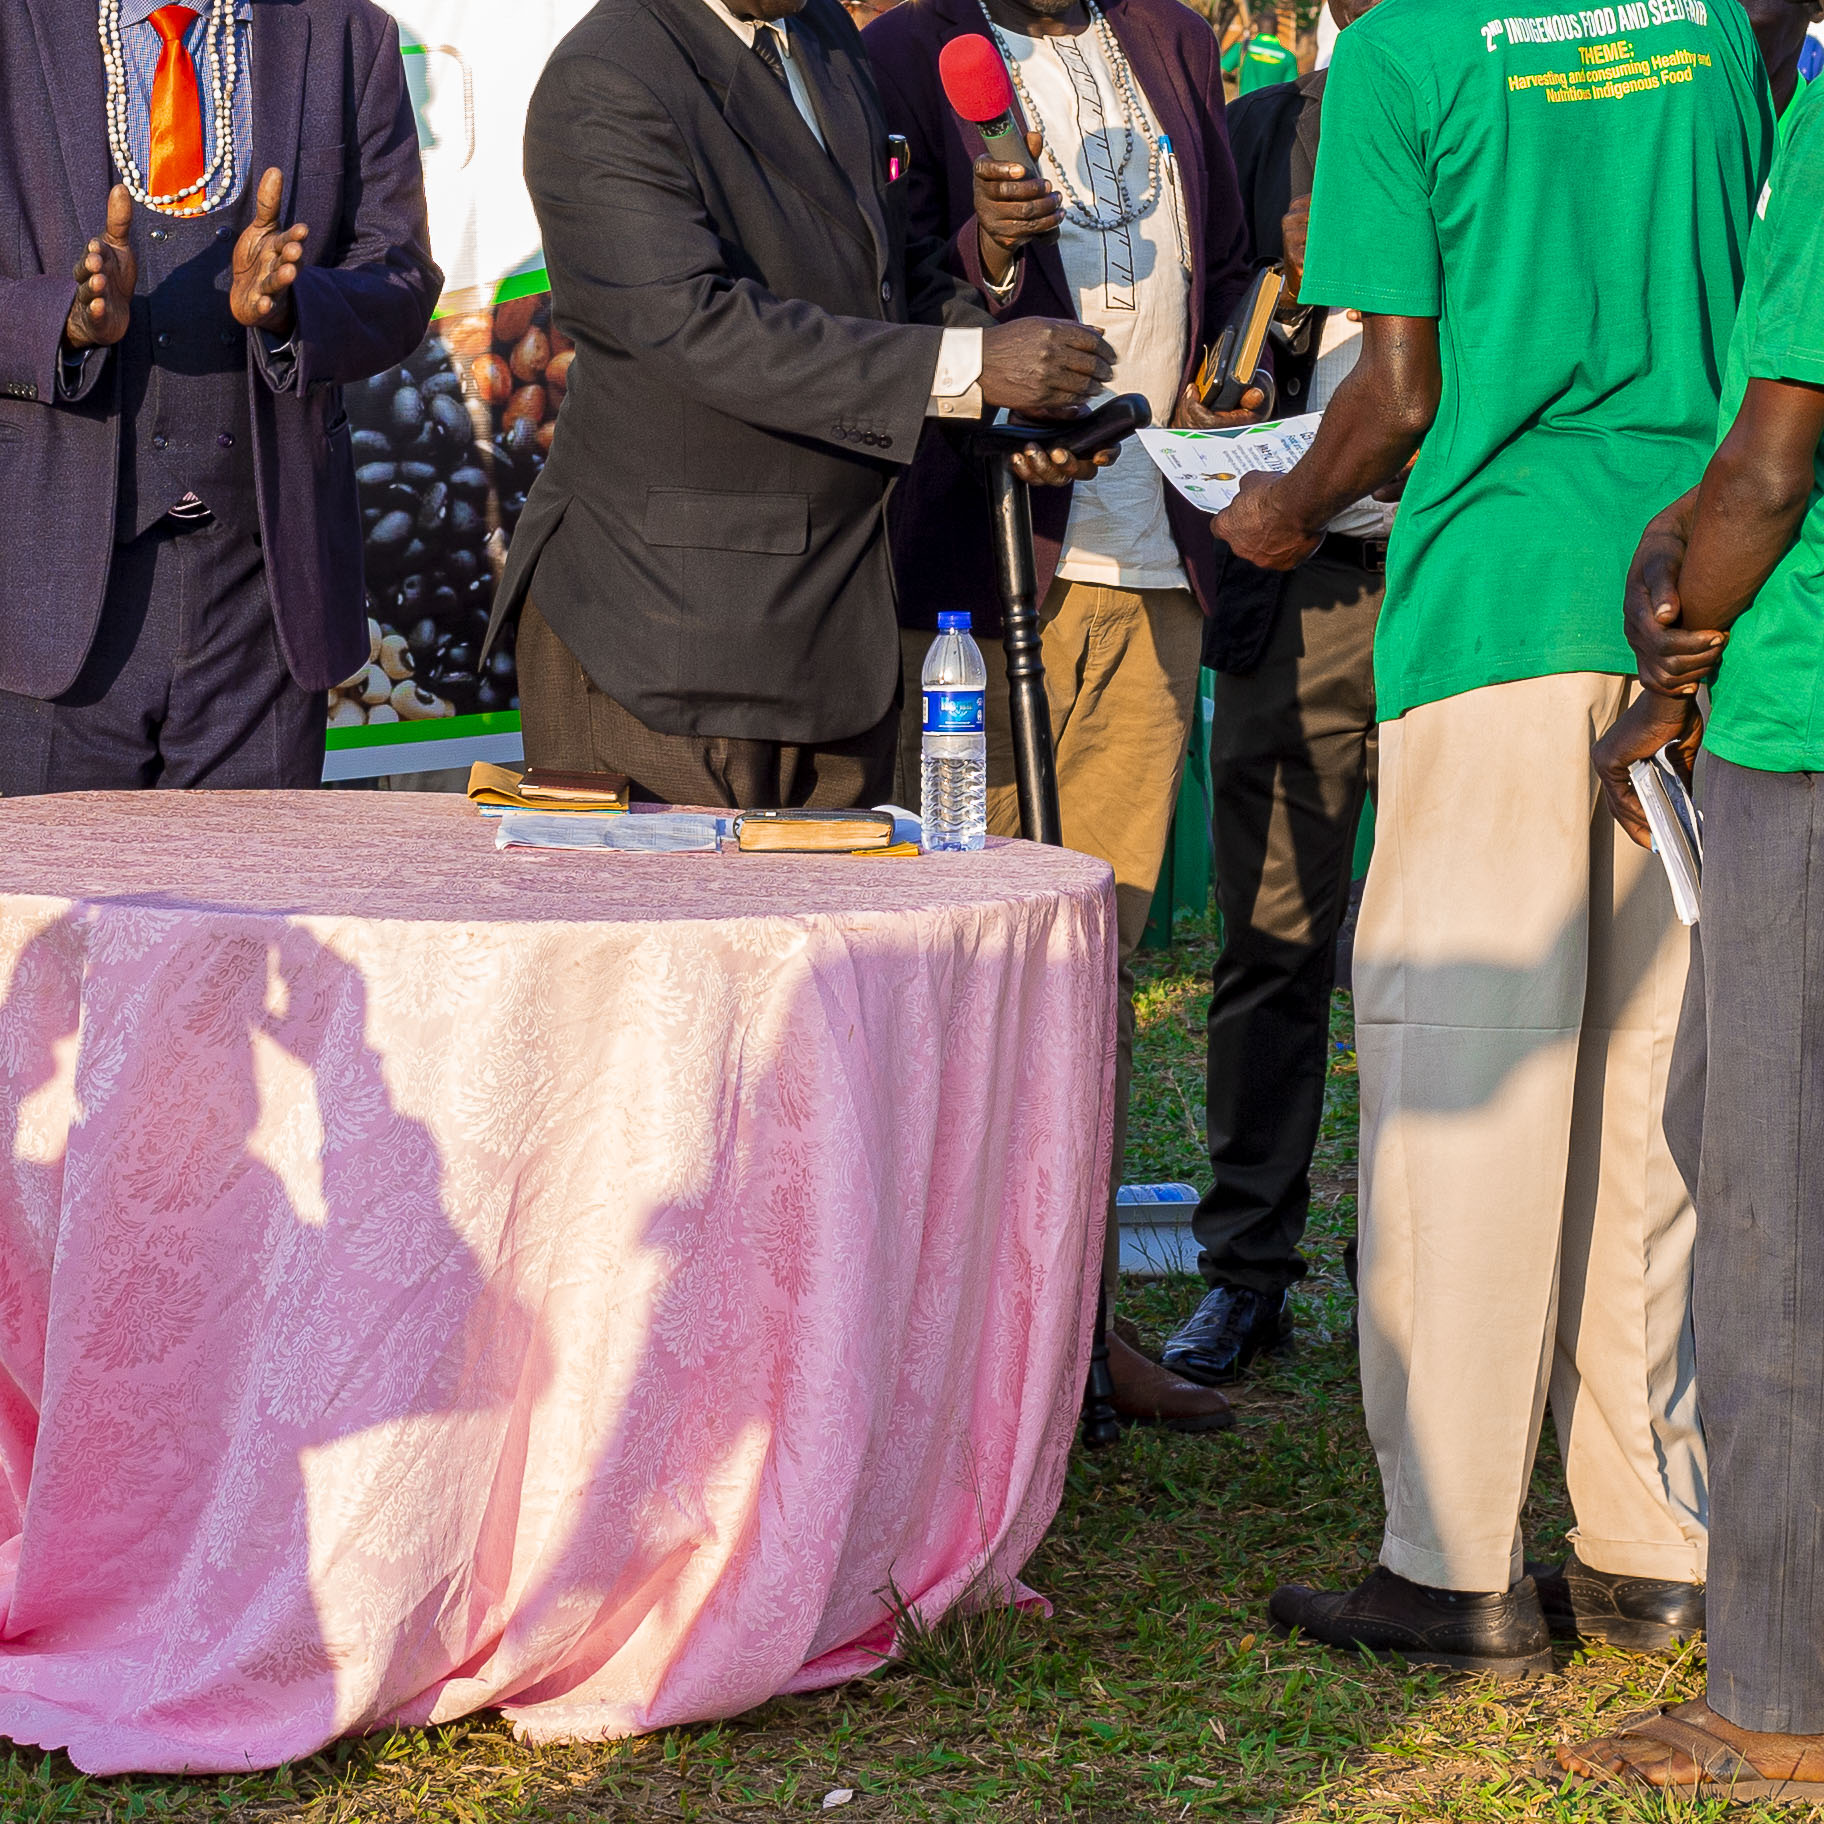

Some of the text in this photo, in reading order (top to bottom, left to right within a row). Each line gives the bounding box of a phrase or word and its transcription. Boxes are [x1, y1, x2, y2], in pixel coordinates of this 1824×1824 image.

[1480, 19, 1504, 53] 2ND
[1503, 14, 1583, 44] INDIGENOUS
[1578, 7, 1618, 38] FOOD
[1617, 1, 1650, 32] AND
[1508, 71, 1569, 93] Harvesting
[1569, 67, 1586, 85] and
[1586, 60, 1651, 83] consuming
[1651, 48, 1697, 69] Healthy
[1578, 40, 1635, 65] THEME:
[1592, 75, 1661, 100] Indigenous
[1661, 65, 1694, 87] Food
